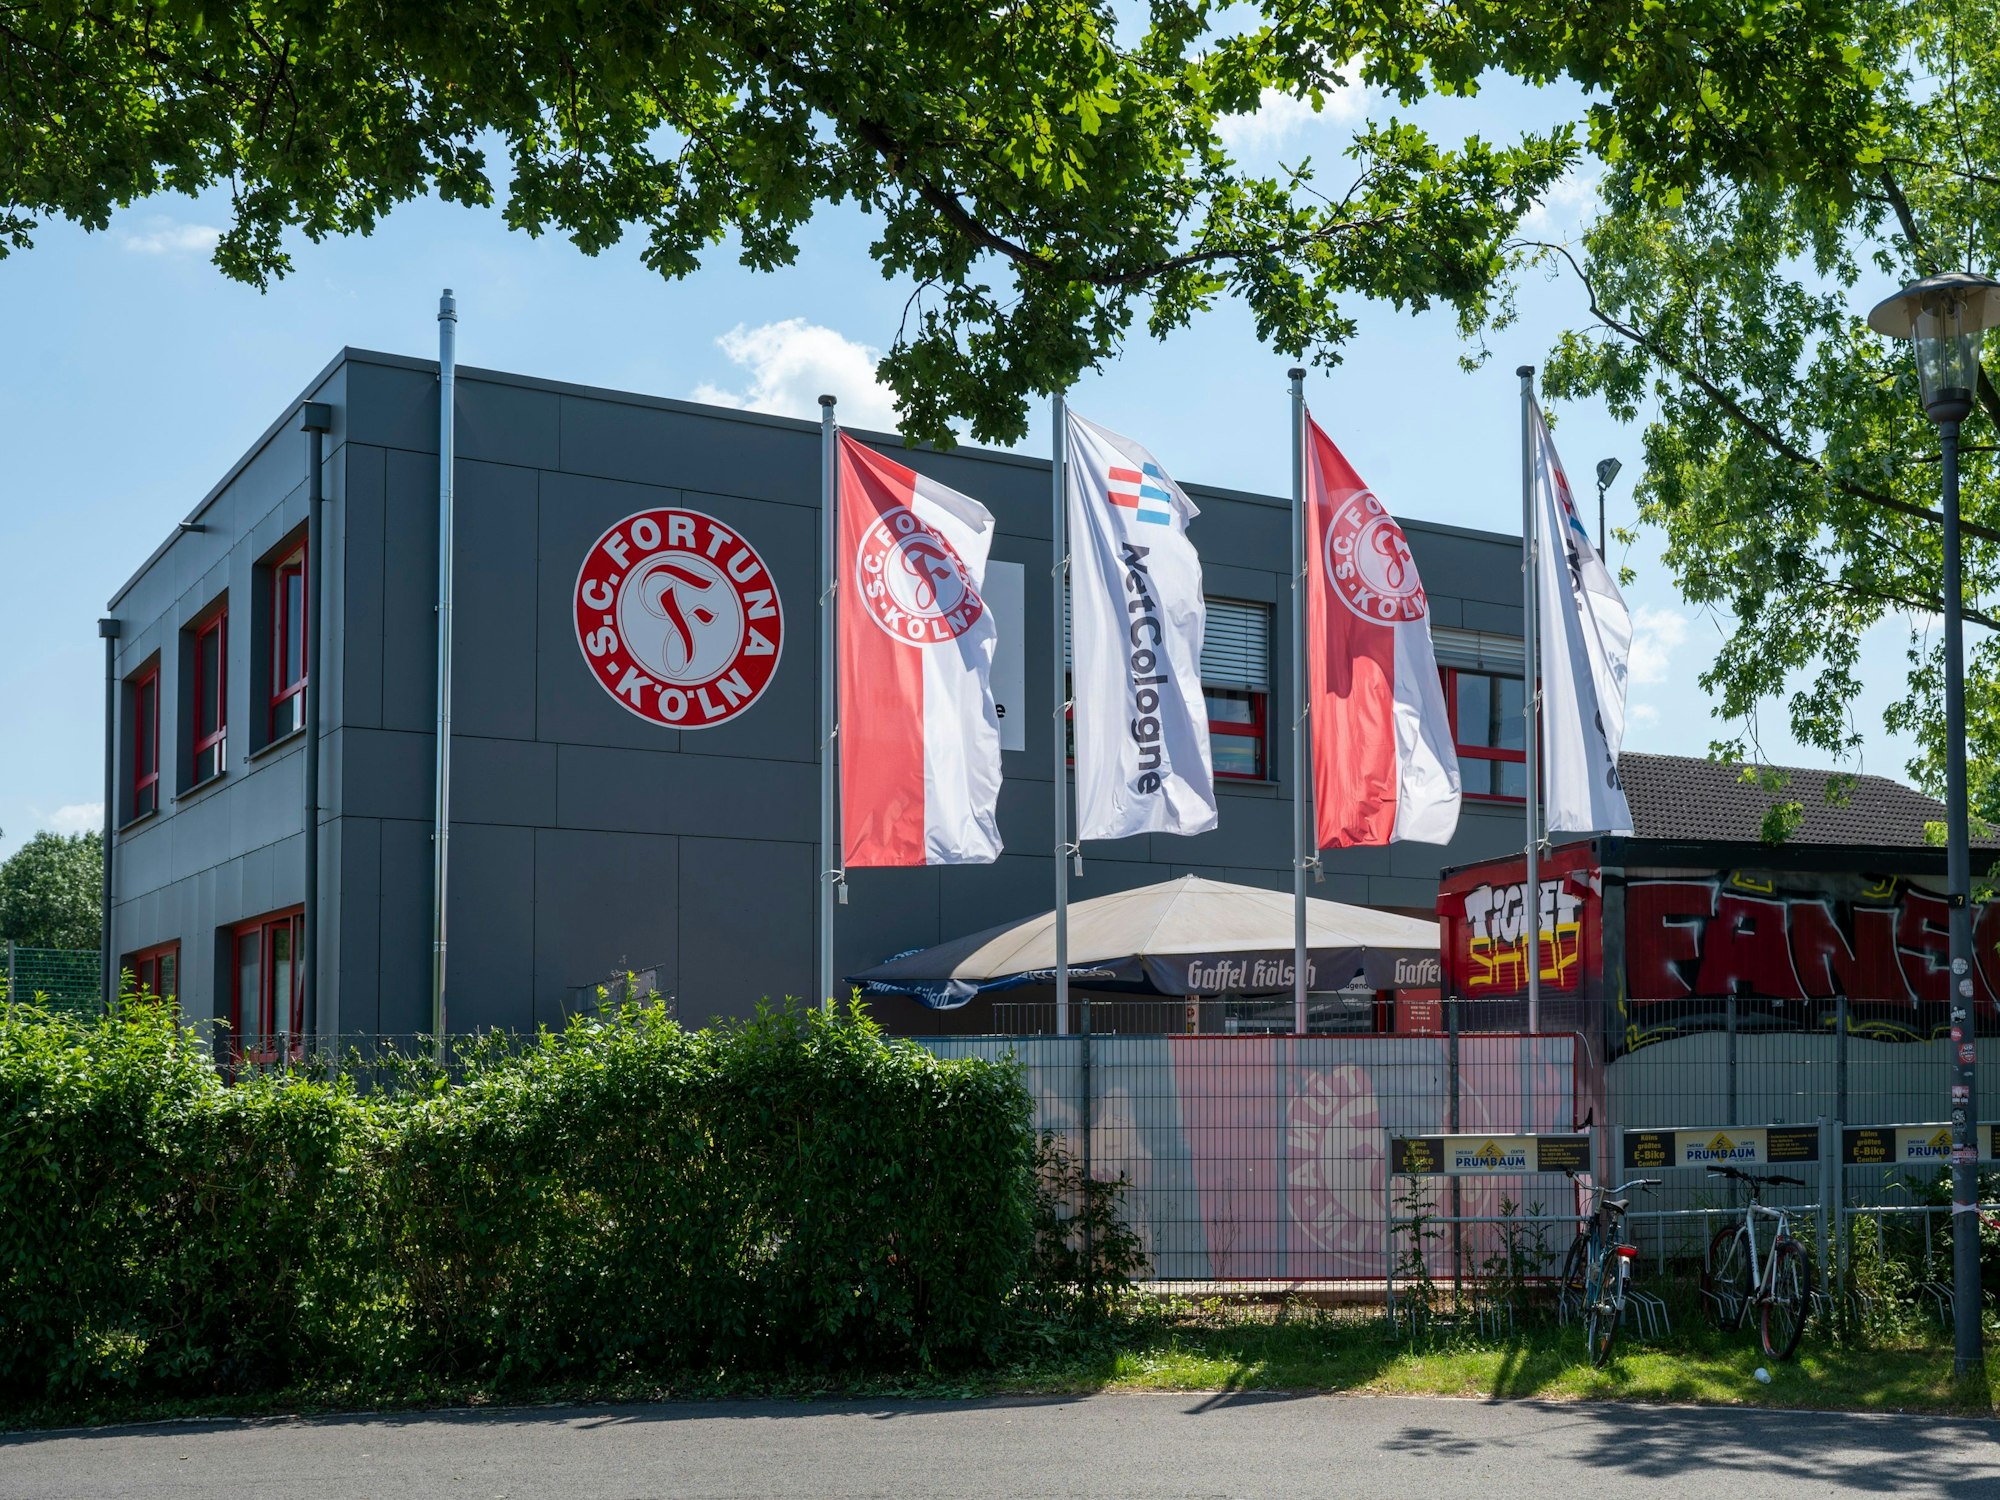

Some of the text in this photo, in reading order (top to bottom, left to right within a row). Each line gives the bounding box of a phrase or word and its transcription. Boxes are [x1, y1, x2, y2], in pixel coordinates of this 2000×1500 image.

[602, 514, 777, 656] FORTUNA
[884, 608, 968, 640] KÖLN
[1121, 541, 1168, 795] NetCologne
[615, 665, 753, 721] KÖLN
[1469, 921, 1581, 993] SHOP
[1187, 957, 1316, 991] Gaffel Kölsh
[1456, 1156, 1526, 1167] PRUMBAUM
[1633, 1150, 1666, 1160] E-Bike
[1687, 1148, 1755, 1160] PRUMBAUM
[1853, 1146, 1886, 1157] E-Bike
[1908, 1146, 1952, 1156] PRUMB
